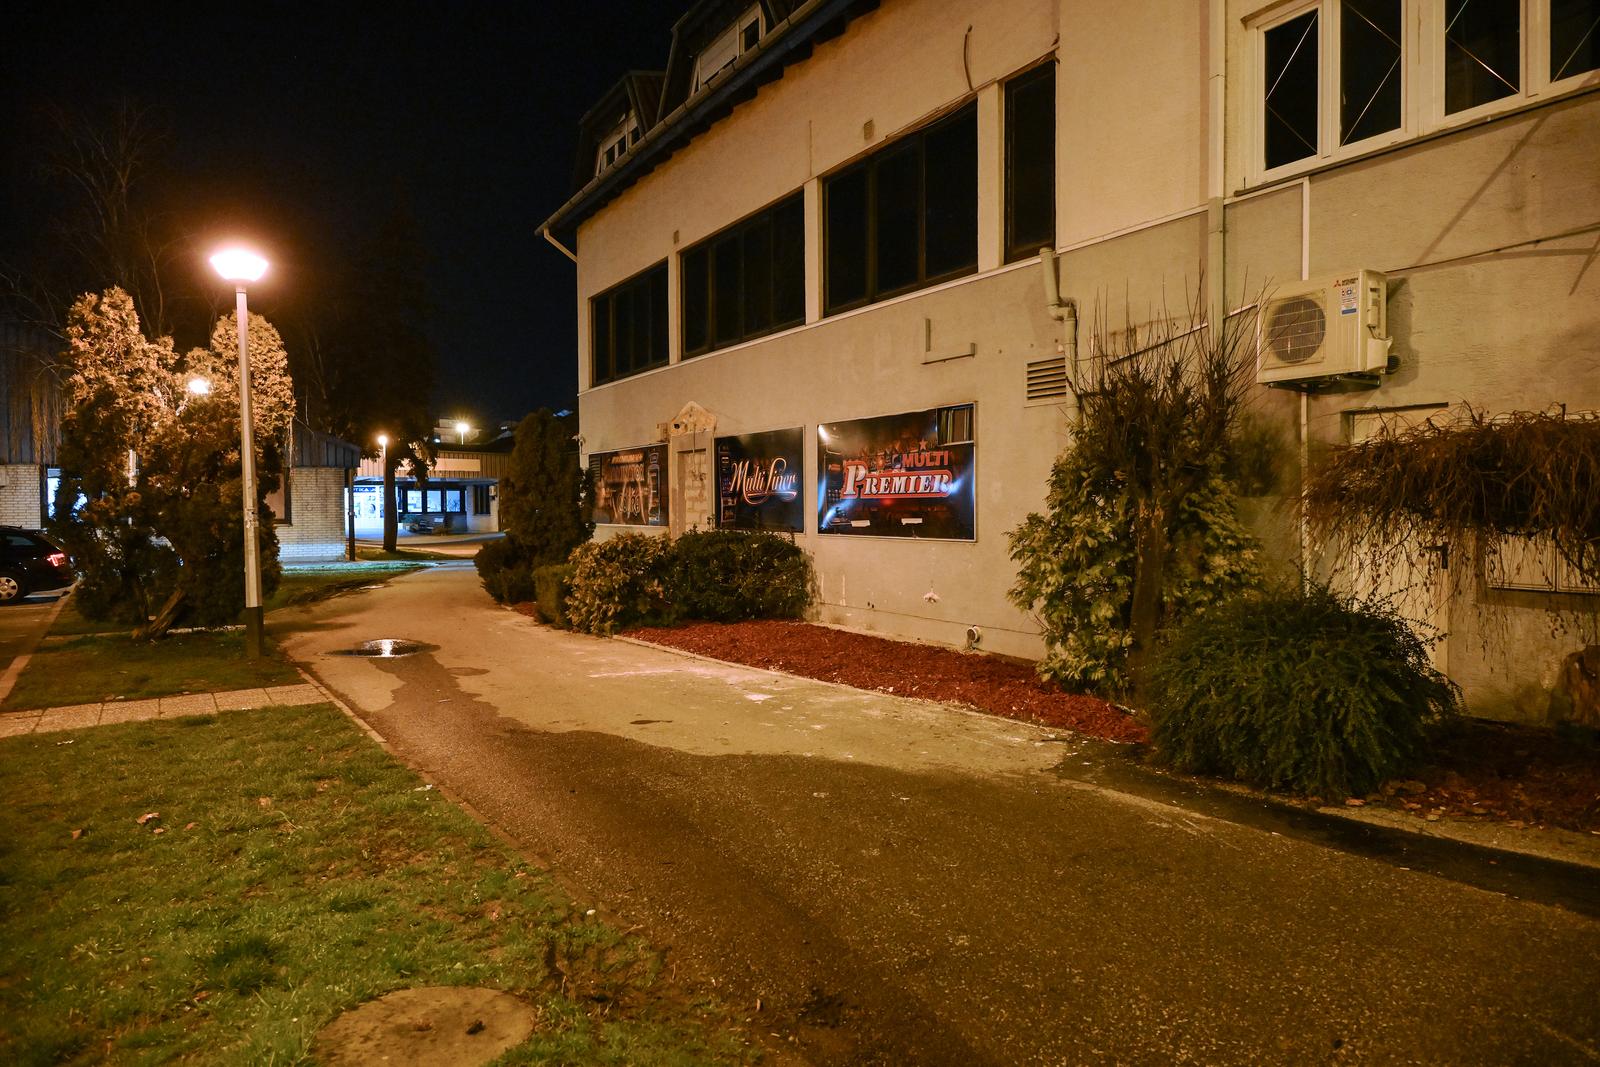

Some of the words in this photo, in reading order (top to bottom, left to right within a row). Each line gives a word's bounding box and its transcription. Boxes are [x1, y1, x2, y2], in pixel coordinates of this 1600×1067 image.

[902, 451, 949, 468] MULTI
[730, 460, 766, 503] Multi
[765, 457, 797, 496] Liner
[843, 463, 952, 496] PREMIER
